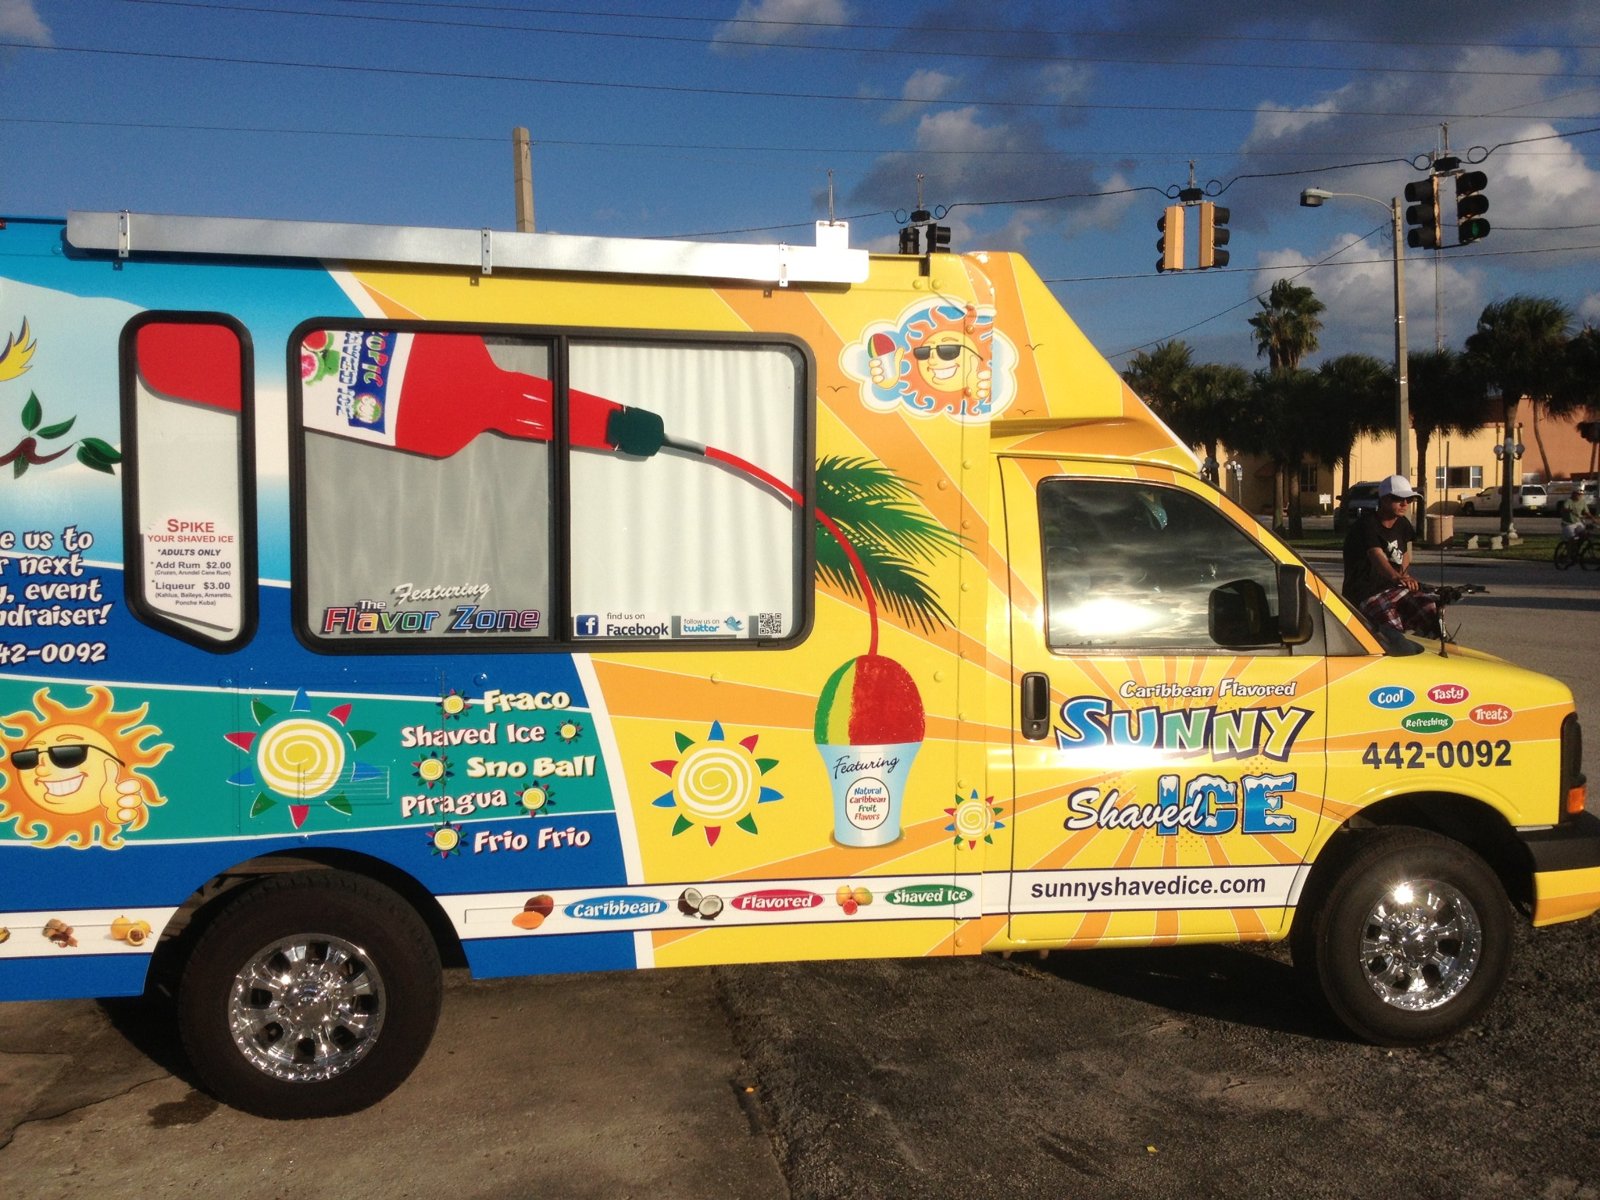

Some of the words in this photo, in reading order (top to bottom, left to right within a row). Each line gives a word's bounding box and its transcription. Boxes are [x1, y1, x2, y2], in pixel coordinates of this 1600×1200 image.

[339, 331, 363, 387] AVED
[167, 518, 215, 533] SPIKE
[23, 529, 54, 550] us
[61, 525, 94, 551] to
[147, 535, 175, 543] YOUR
[177, 535, 216, 543] SHAVED
[218, 535, 234, 543] ICE
[197, 548, 221, 557] ONLY
[20, 553, 84, 577] next
[155, 561, 176, 569] Add
[178, 561, 201, 569] Rum
[206, 561, 232, 570] $2.00
[24, 578, 103, 602] event
[155, 582, 196, 591] Liqueur
[203, 582, 231, 590] $3.00
[394, 582, 491, 606] Featuring
[359, 600, 387, 611] The
[322, 606, 441, 633] Flavor
[449, 604, 541, 632] Zone
[606, 612, 623, 621] find
[606, 623, 669, 637] Facebook
[683, 624, 720, 633] twitter
[1120, 680, 1215, 699] Caribbean
[1218, 678, 1298, 698] Flavored
[1377, 689, 1405, 704] Cool
[1432, 687, 1465, 700] Tasty
[483, 689, 571, 714] Fraco
[1405, 717, 1449, 728] Refreshing
[1475, 708, 1509, 721] Treats
[401, 722, 498, 747] Shaved
[506, 723, 546, 744] Ice
[1054, 695, 1315, 762] SUNNY
[1362, 739, 1513, 770] 442-0092
[467, 757, 527, 778] Sno
[533, 755, 597, 778] Ball
[833, 755, 900, 780] Featuring
[849, 795, 887, 804] Caribbean
[854, 787, 882, 796] Natural
[401, 789, 508, 818] Piragua
[858, 804, 877, 813] Fruit
[1064, 786, 1206, 831] Shaved
[1157, 772, 1297, 836] ICE
[854, 812, 881, 821] Flavors
[474, 830, 528, 854] Frio
[538, 827, 591, 850] Frio
[893, 888, 944, 904] Shaved
[947, 888, 968, 902] Ice
[1031, 875, 1266, 902] sunnyshavedice.com
[573, 899, 661, 918] Caribbean
[741, 894, 814, 910] Flavored
